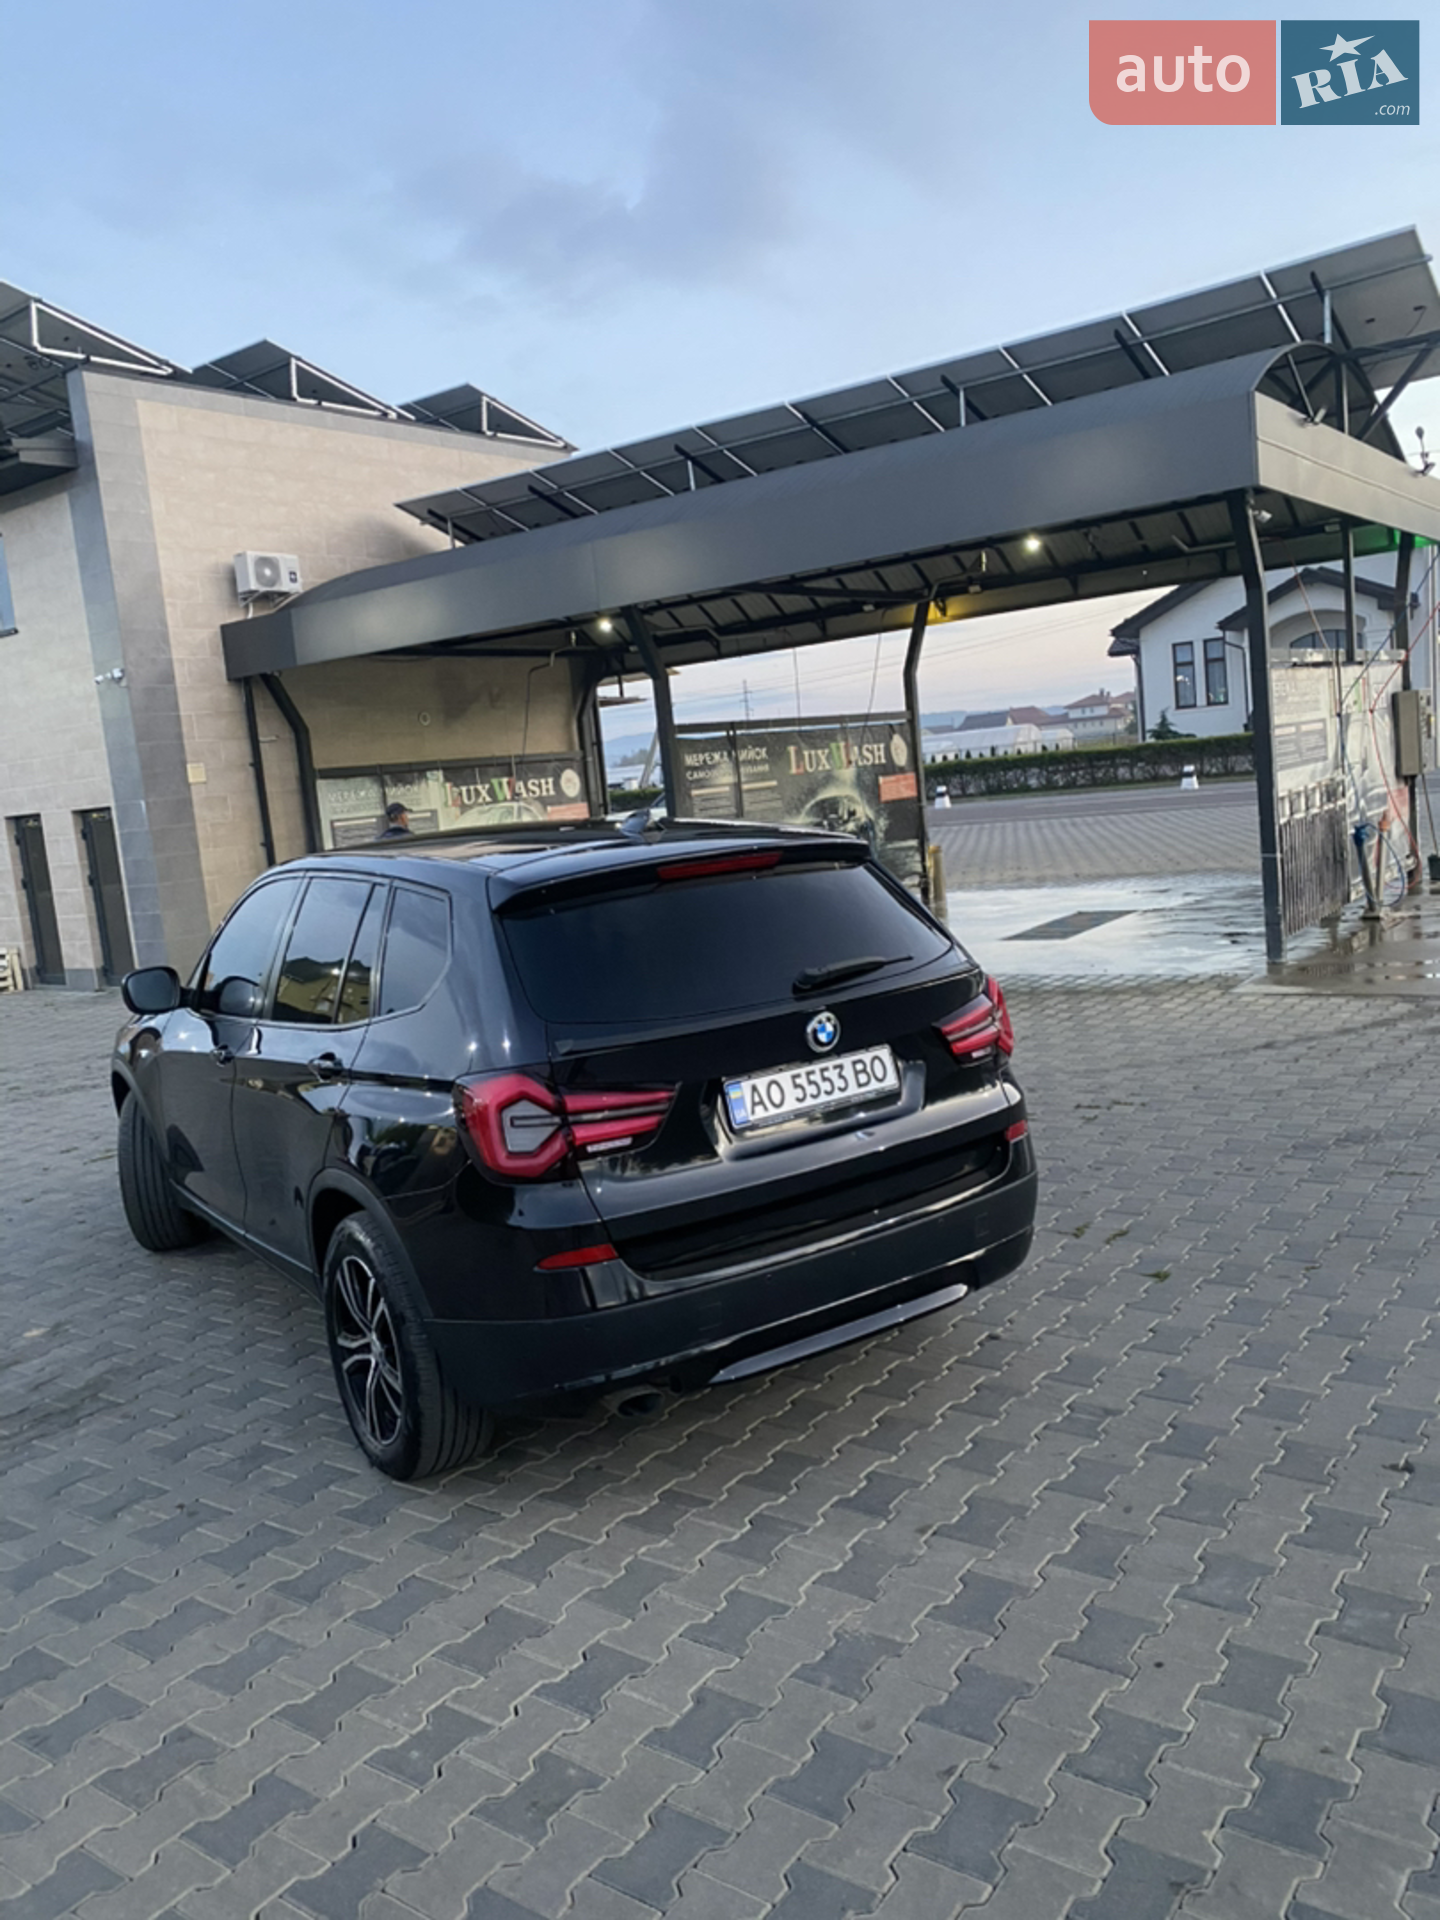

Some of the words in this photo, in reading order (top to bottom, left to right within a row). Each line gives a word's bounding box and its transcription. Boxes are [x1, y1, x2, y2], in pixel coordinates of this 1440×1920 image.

[751, 1079, 785, 1116] AO
[791, 1063, 849, 1102] 5553
[852, 1055, 888, 1089] BO
